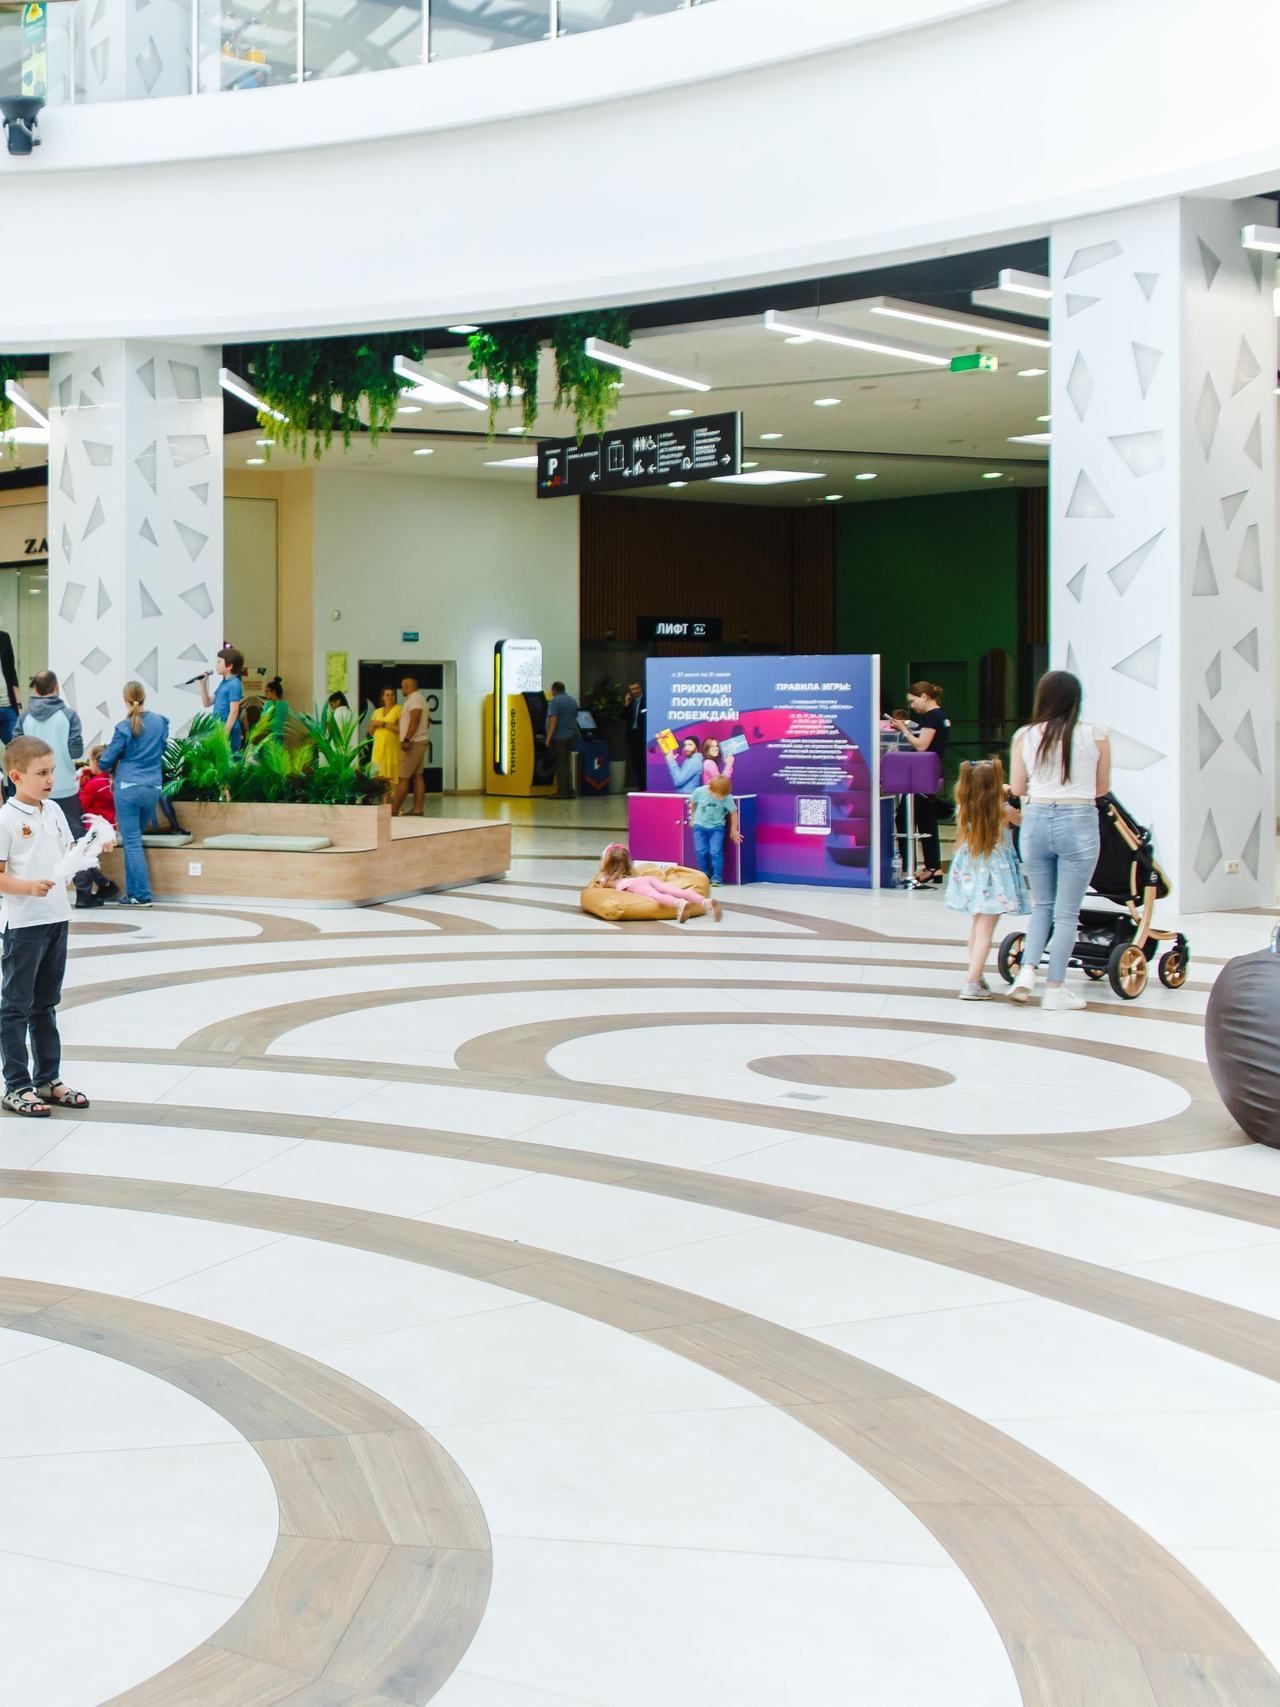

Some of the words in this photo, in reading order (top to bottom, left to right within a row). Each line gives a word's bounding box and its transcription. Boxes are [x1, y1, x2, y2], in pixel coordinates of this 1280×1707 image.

[656, 622, 688, 634] ЛИФТ
[672, 684, 732, 694] ПРИХОДИ!
[672, 695, 732, 706] ПОКУПАЙ!
[668, 708, 740, 722] ПОБЕЖДАЙ!
